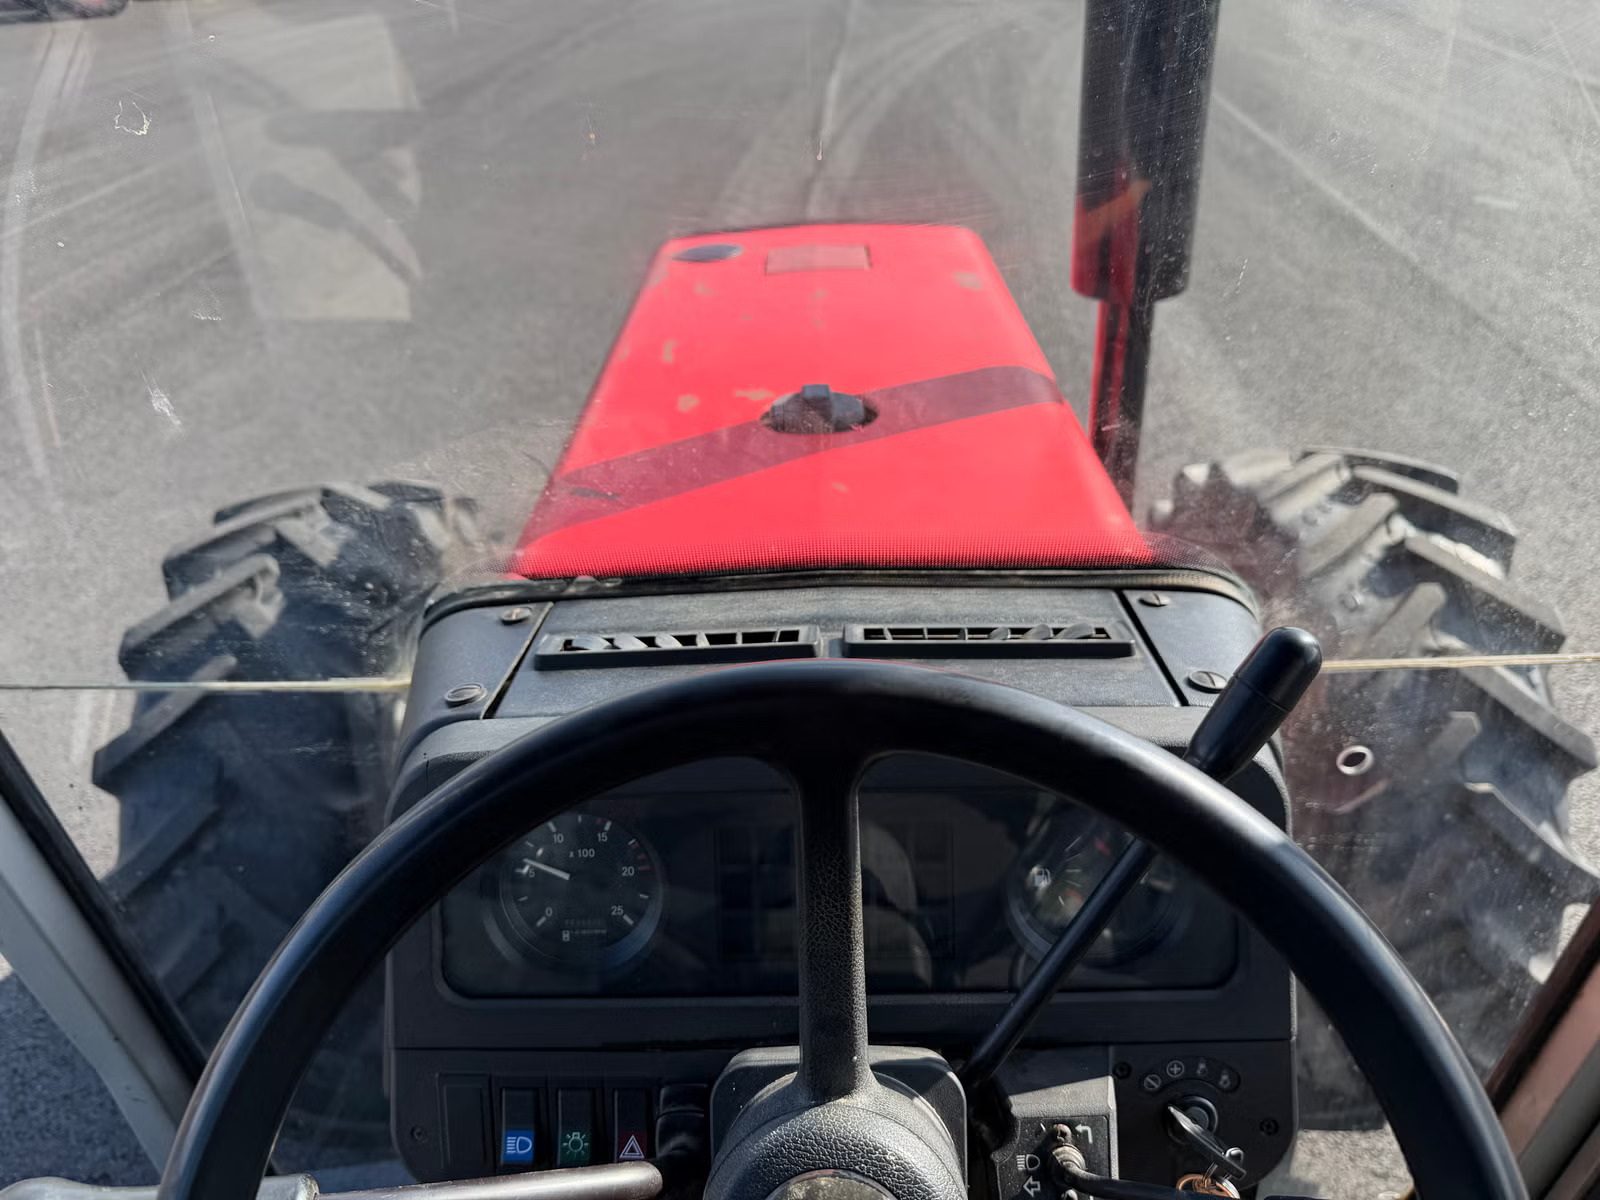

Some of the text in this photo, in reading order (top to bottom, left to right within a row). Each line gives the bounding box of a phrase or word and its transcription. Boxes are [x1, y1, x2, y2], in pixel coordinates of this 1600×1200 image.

[553, 833, 564, 843] 10
[597, 832, 608, 842] 15
[578, 848, 595, 858] 100
[529, 868, 536, 878] 5
[622, 866, 635, 877] 20
[545, 907, 553, 917] 0
[611, 905, 624, 916] 25
